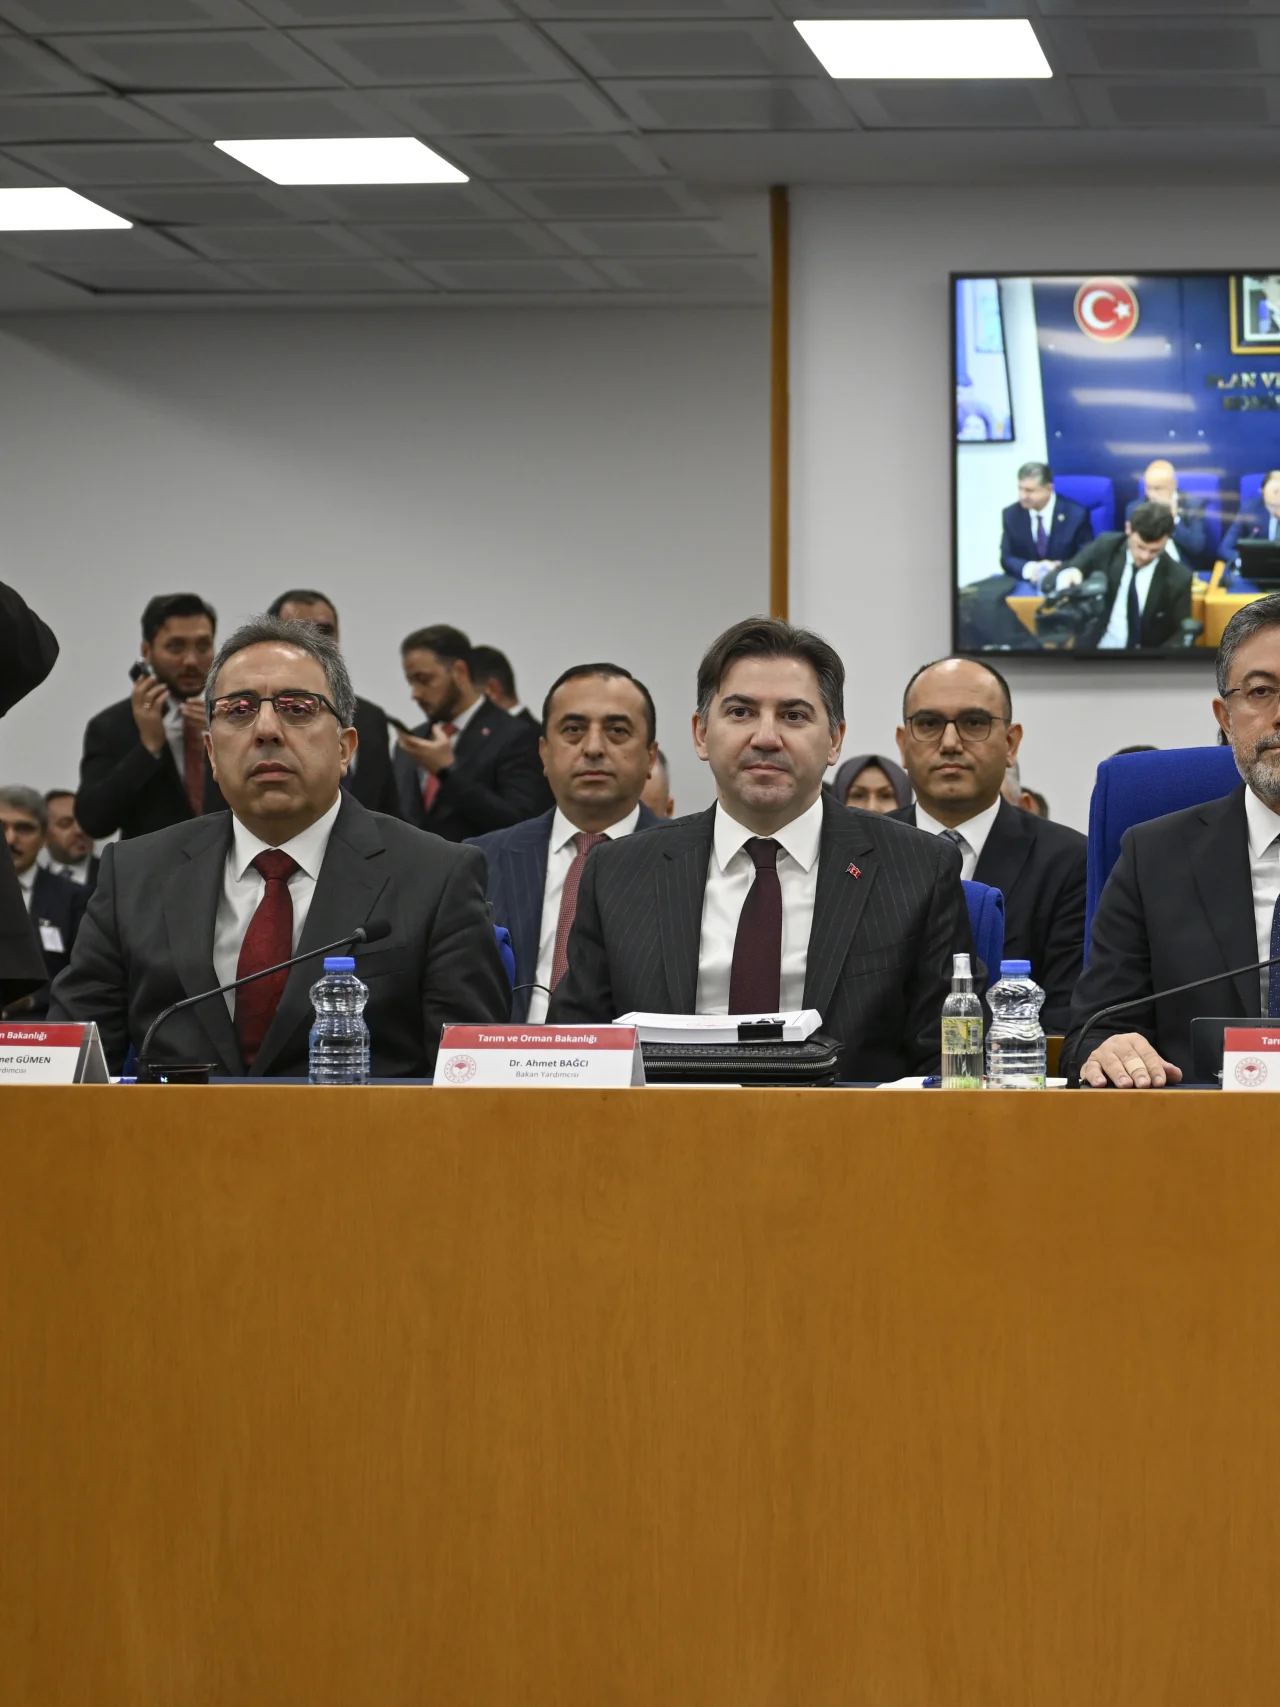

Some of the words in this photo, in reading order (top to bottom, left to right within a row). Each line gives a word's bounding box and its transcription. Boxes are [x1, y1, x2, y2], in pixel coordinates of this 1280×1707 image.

[7, 1031, 47, 1041] Bakanlığı
[478, 1034, 505, 1042] Tarım
[520, 1034, 553, 1042] Orman
[555, 1034, 598, 1044] Bakanlığı
[16, 1054, 51, 1064] GÜMEN
[509, 1059, 523, 1067] Dr.
[525, 1059, 557, 1068] Ahmet
[559, 1058, 589, 1068] BAĞCI
